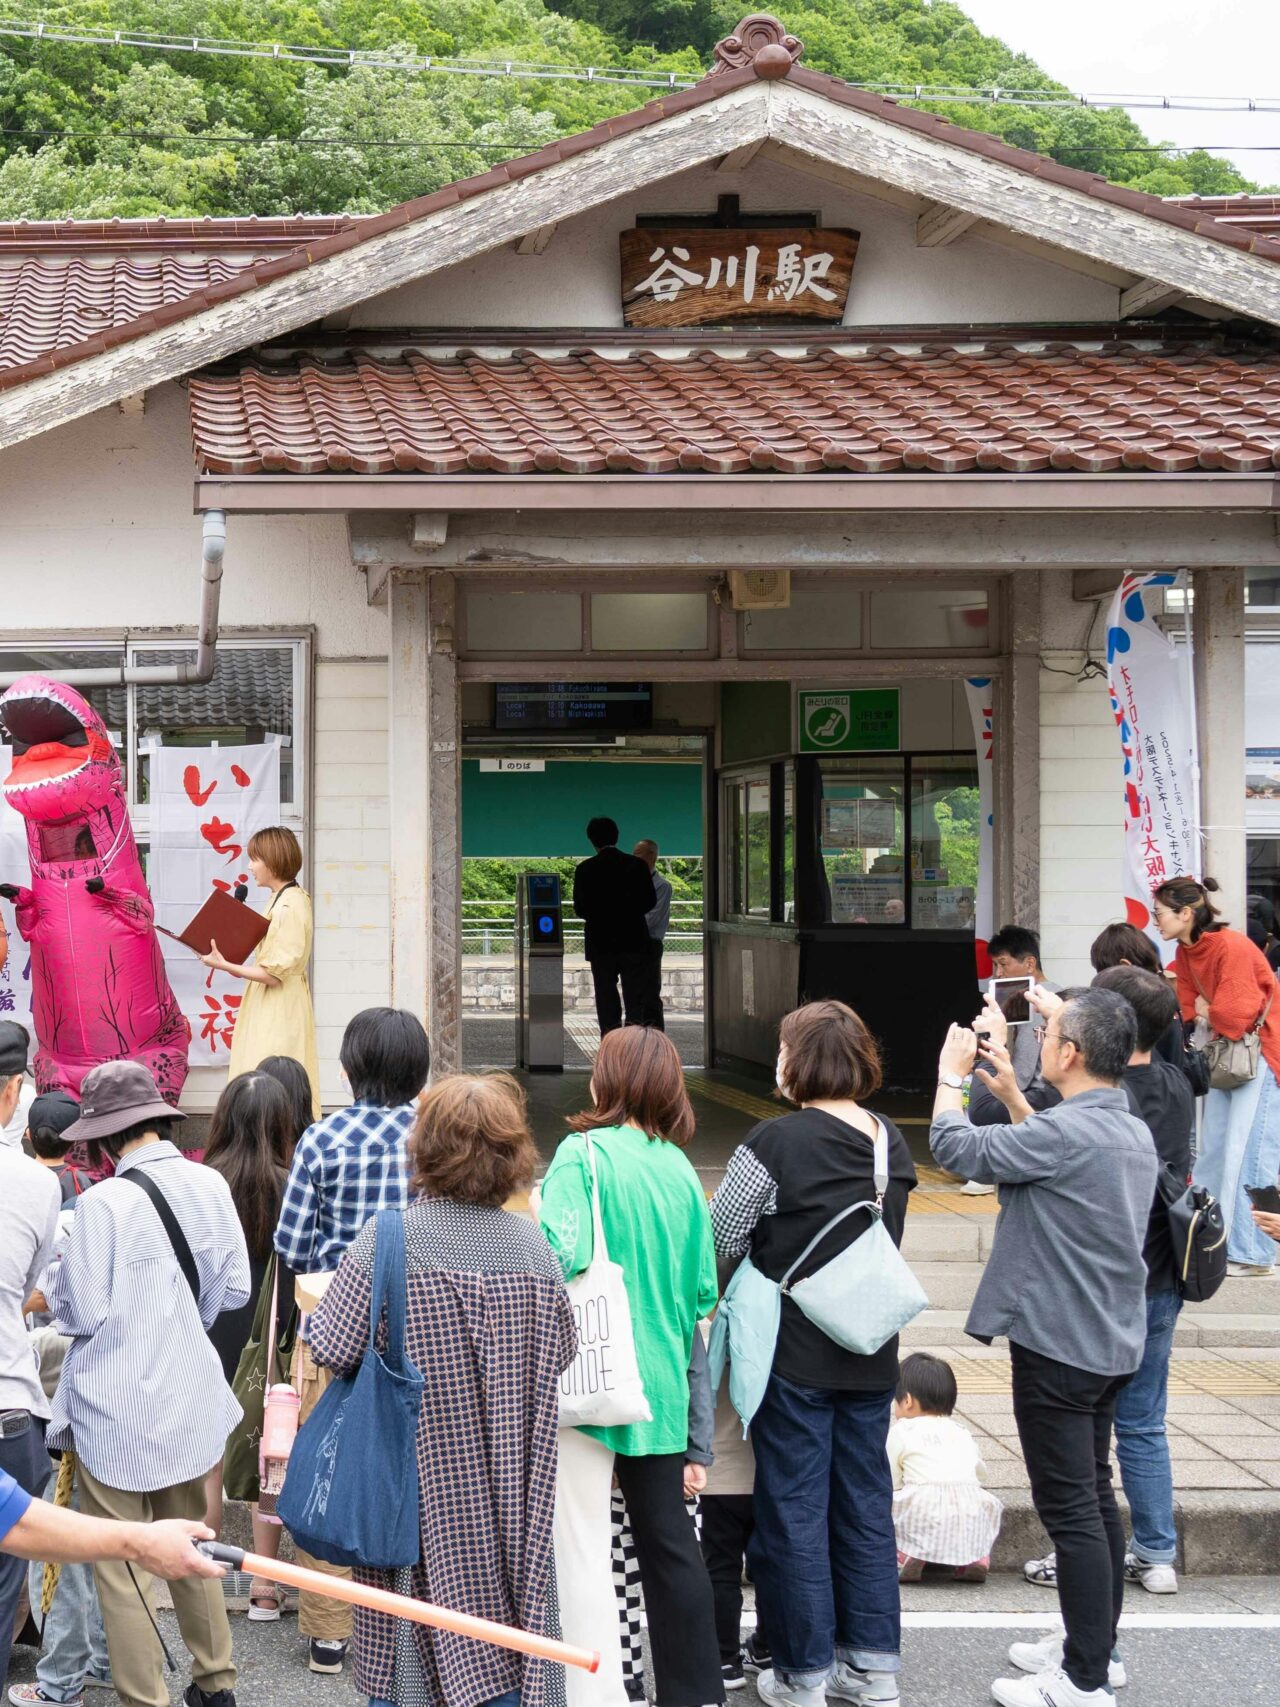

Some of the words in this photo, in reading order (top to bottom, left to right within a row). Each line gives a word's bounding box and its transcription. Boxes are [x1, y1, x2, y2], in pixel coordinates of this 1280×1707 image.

[634, 243, 838, 304] 谷川駅
[507, 762, 531, 770] のりば
